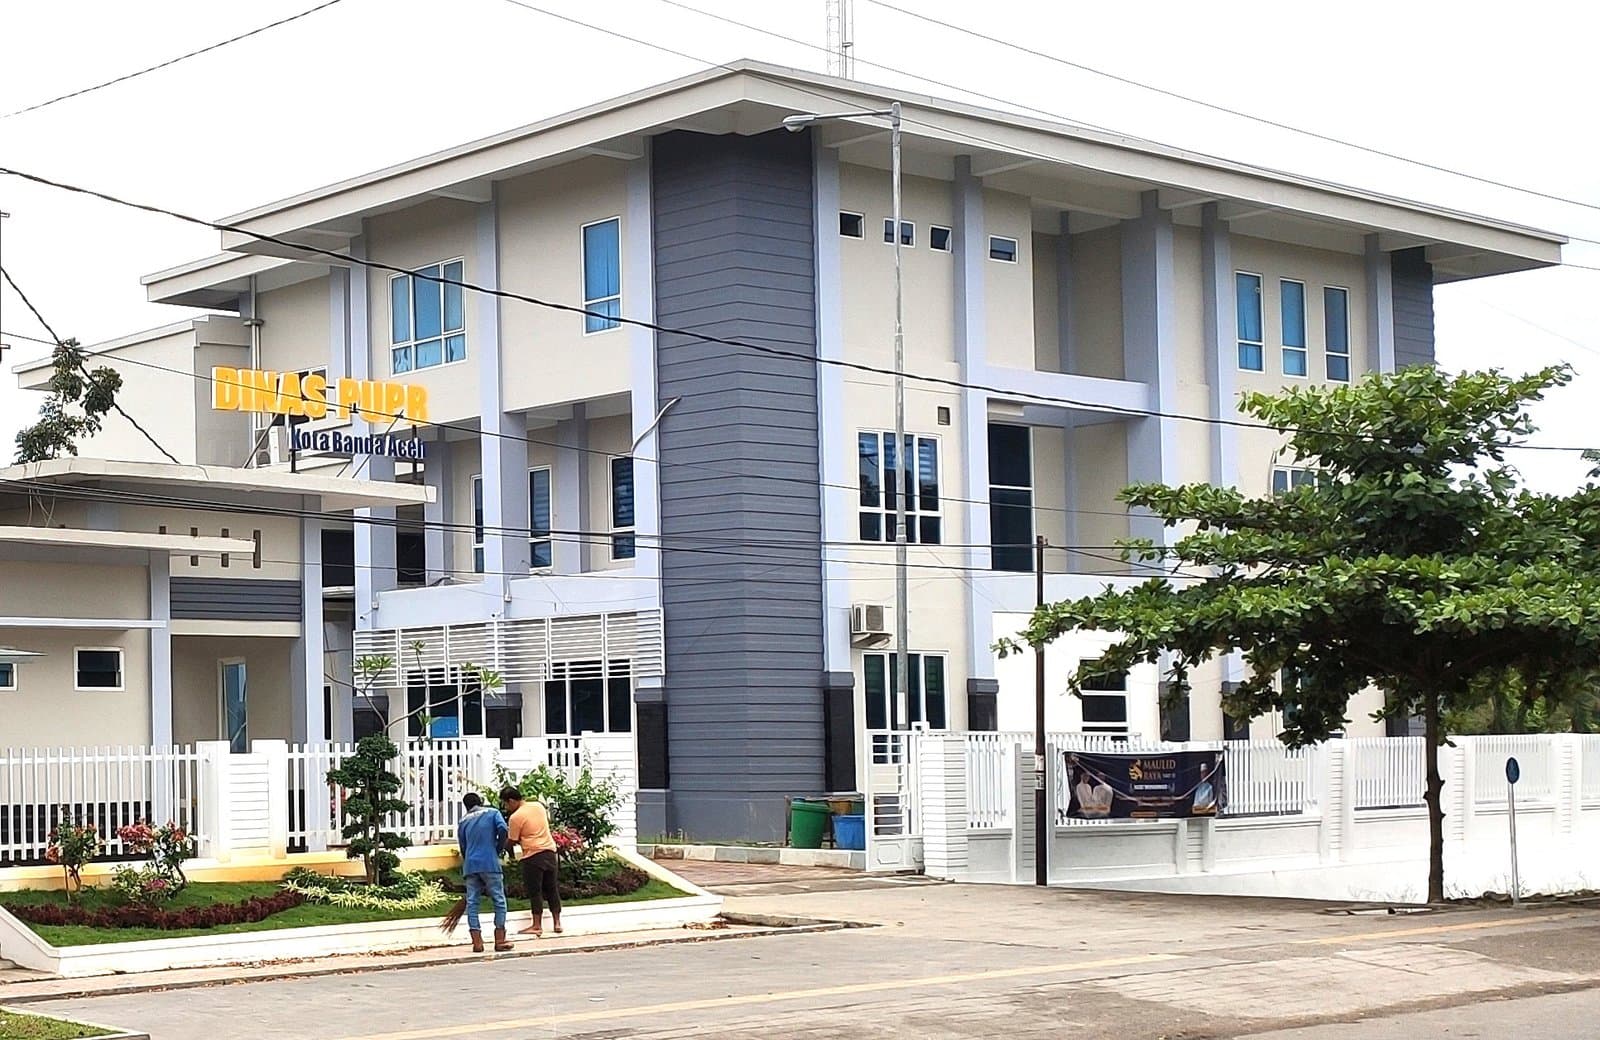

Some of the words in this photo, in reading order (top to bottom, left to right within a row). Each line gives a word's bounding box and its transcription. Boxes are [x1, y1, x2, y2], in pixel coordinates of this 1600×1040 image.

[212, 366, 327, 418] DINAS
[335, 377, 430, 426] PUPR
[291, 427, 331, 451] Kota
[332, 430, 385, 456] Banda
[385, 434, 426, 459] Aceh
[1143, 759, 1176, 770] MAULID
